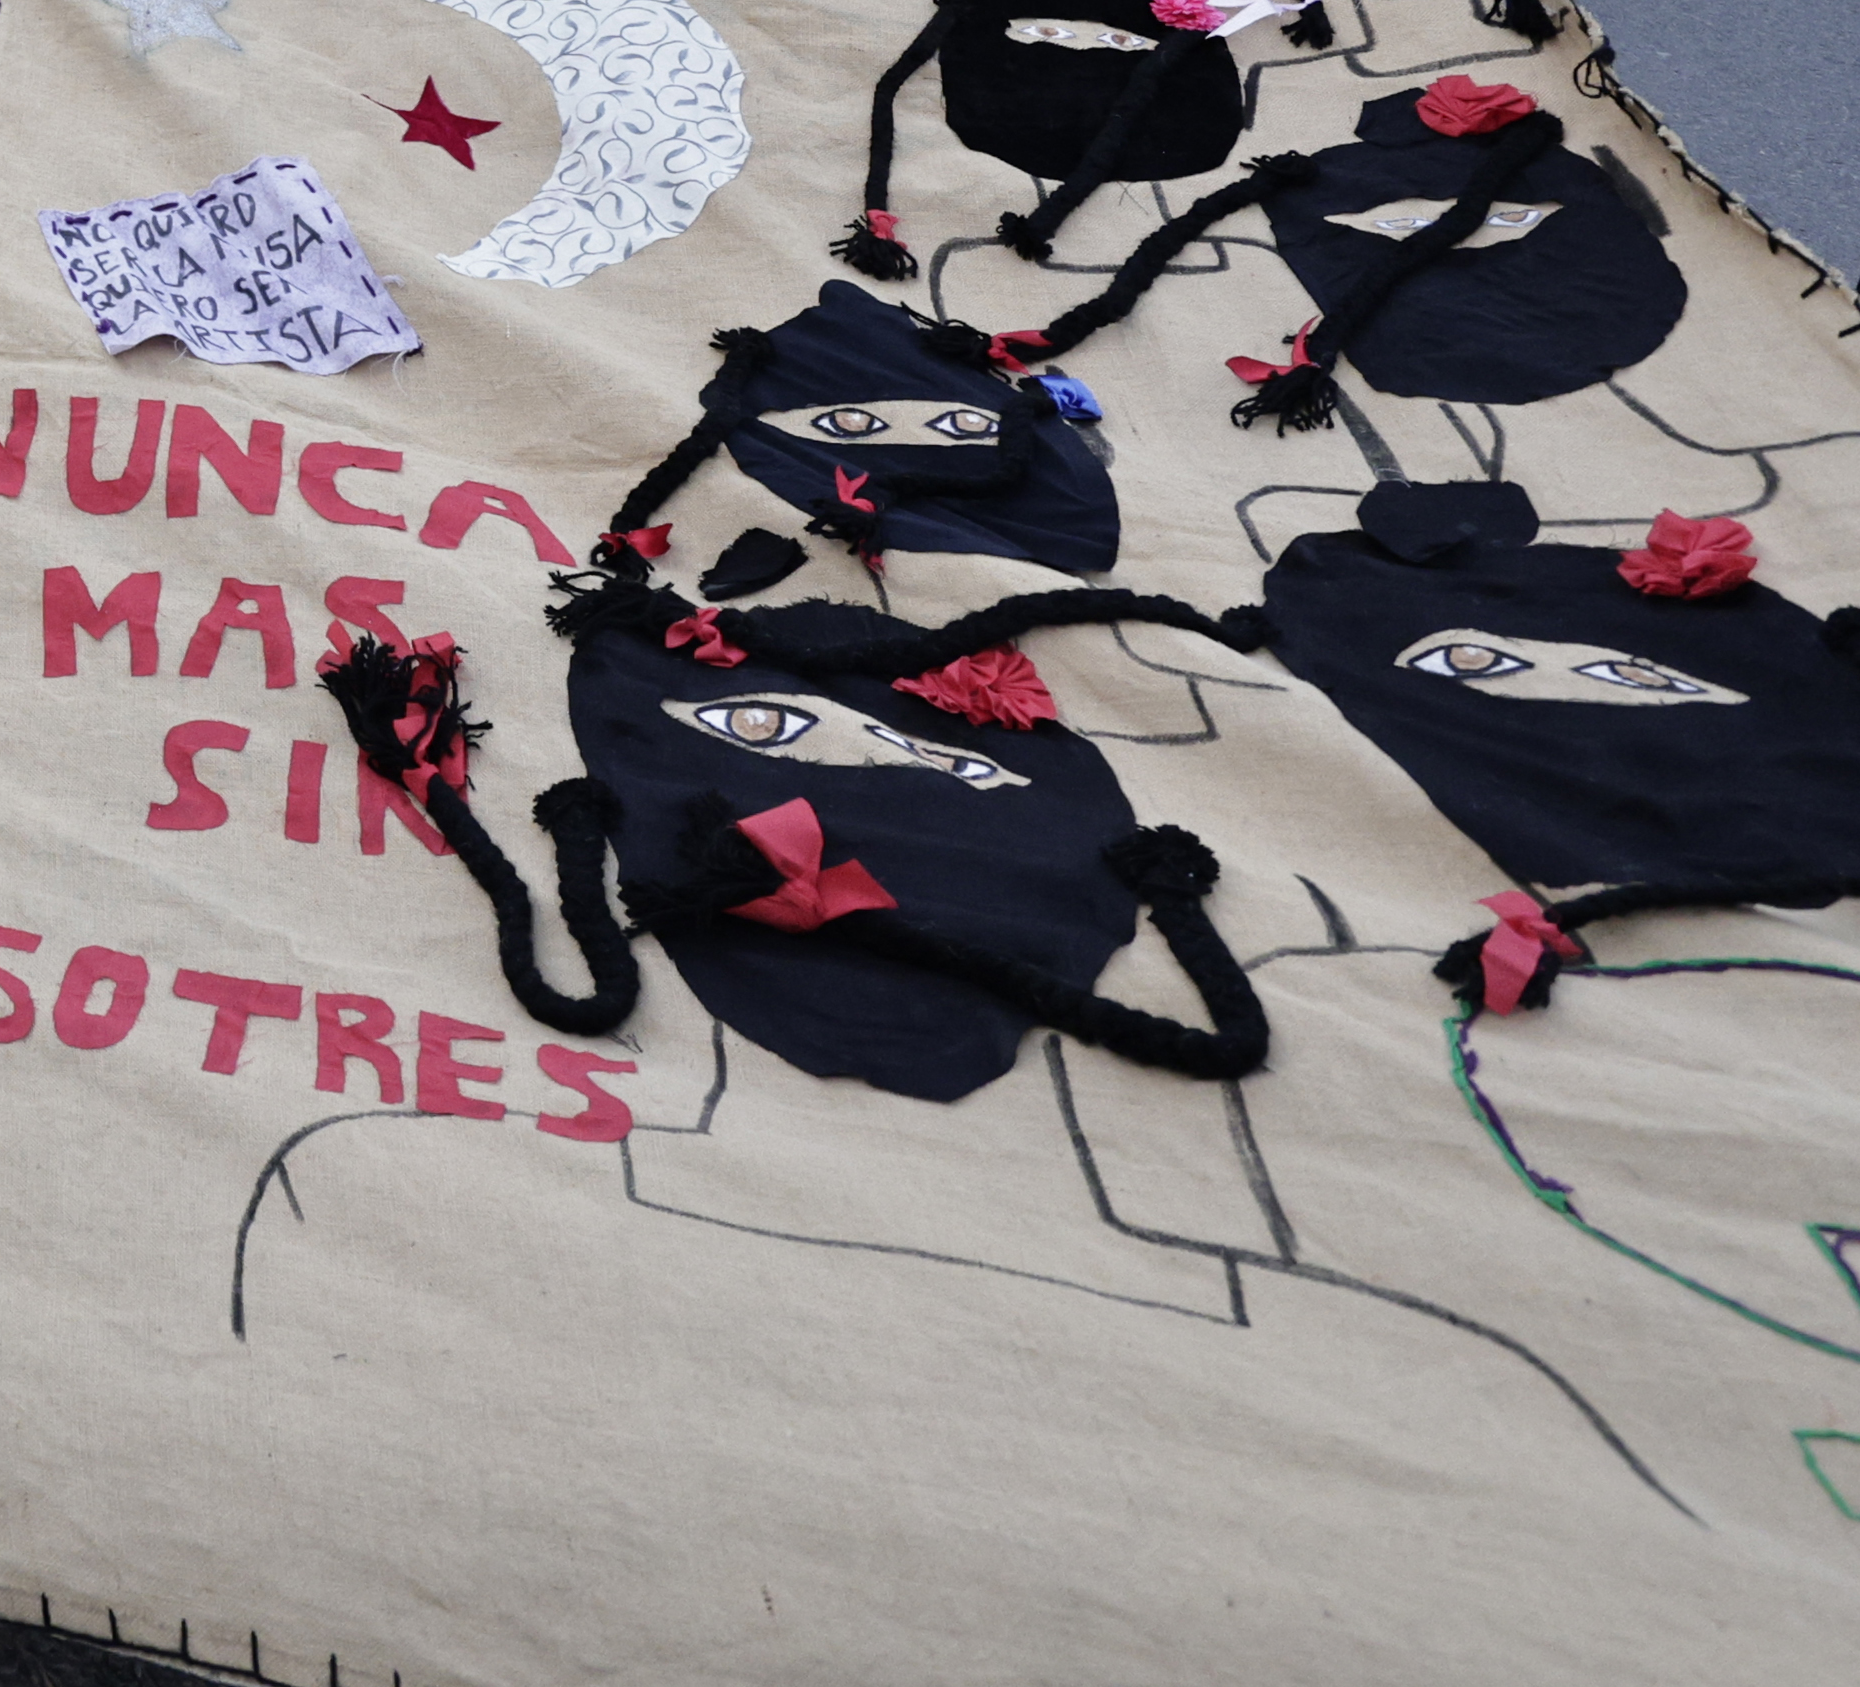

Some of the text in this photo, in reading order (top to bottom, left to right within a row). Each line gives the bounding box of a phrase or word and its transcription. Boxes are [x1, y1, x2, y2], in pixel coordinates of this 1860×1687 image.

[133, 191, 257, 252] QUIRO
[154, 246, 206, 288] LA
[174, 305, 383, 363] ARTISTA
[42, 565, 407, 688] MAS
